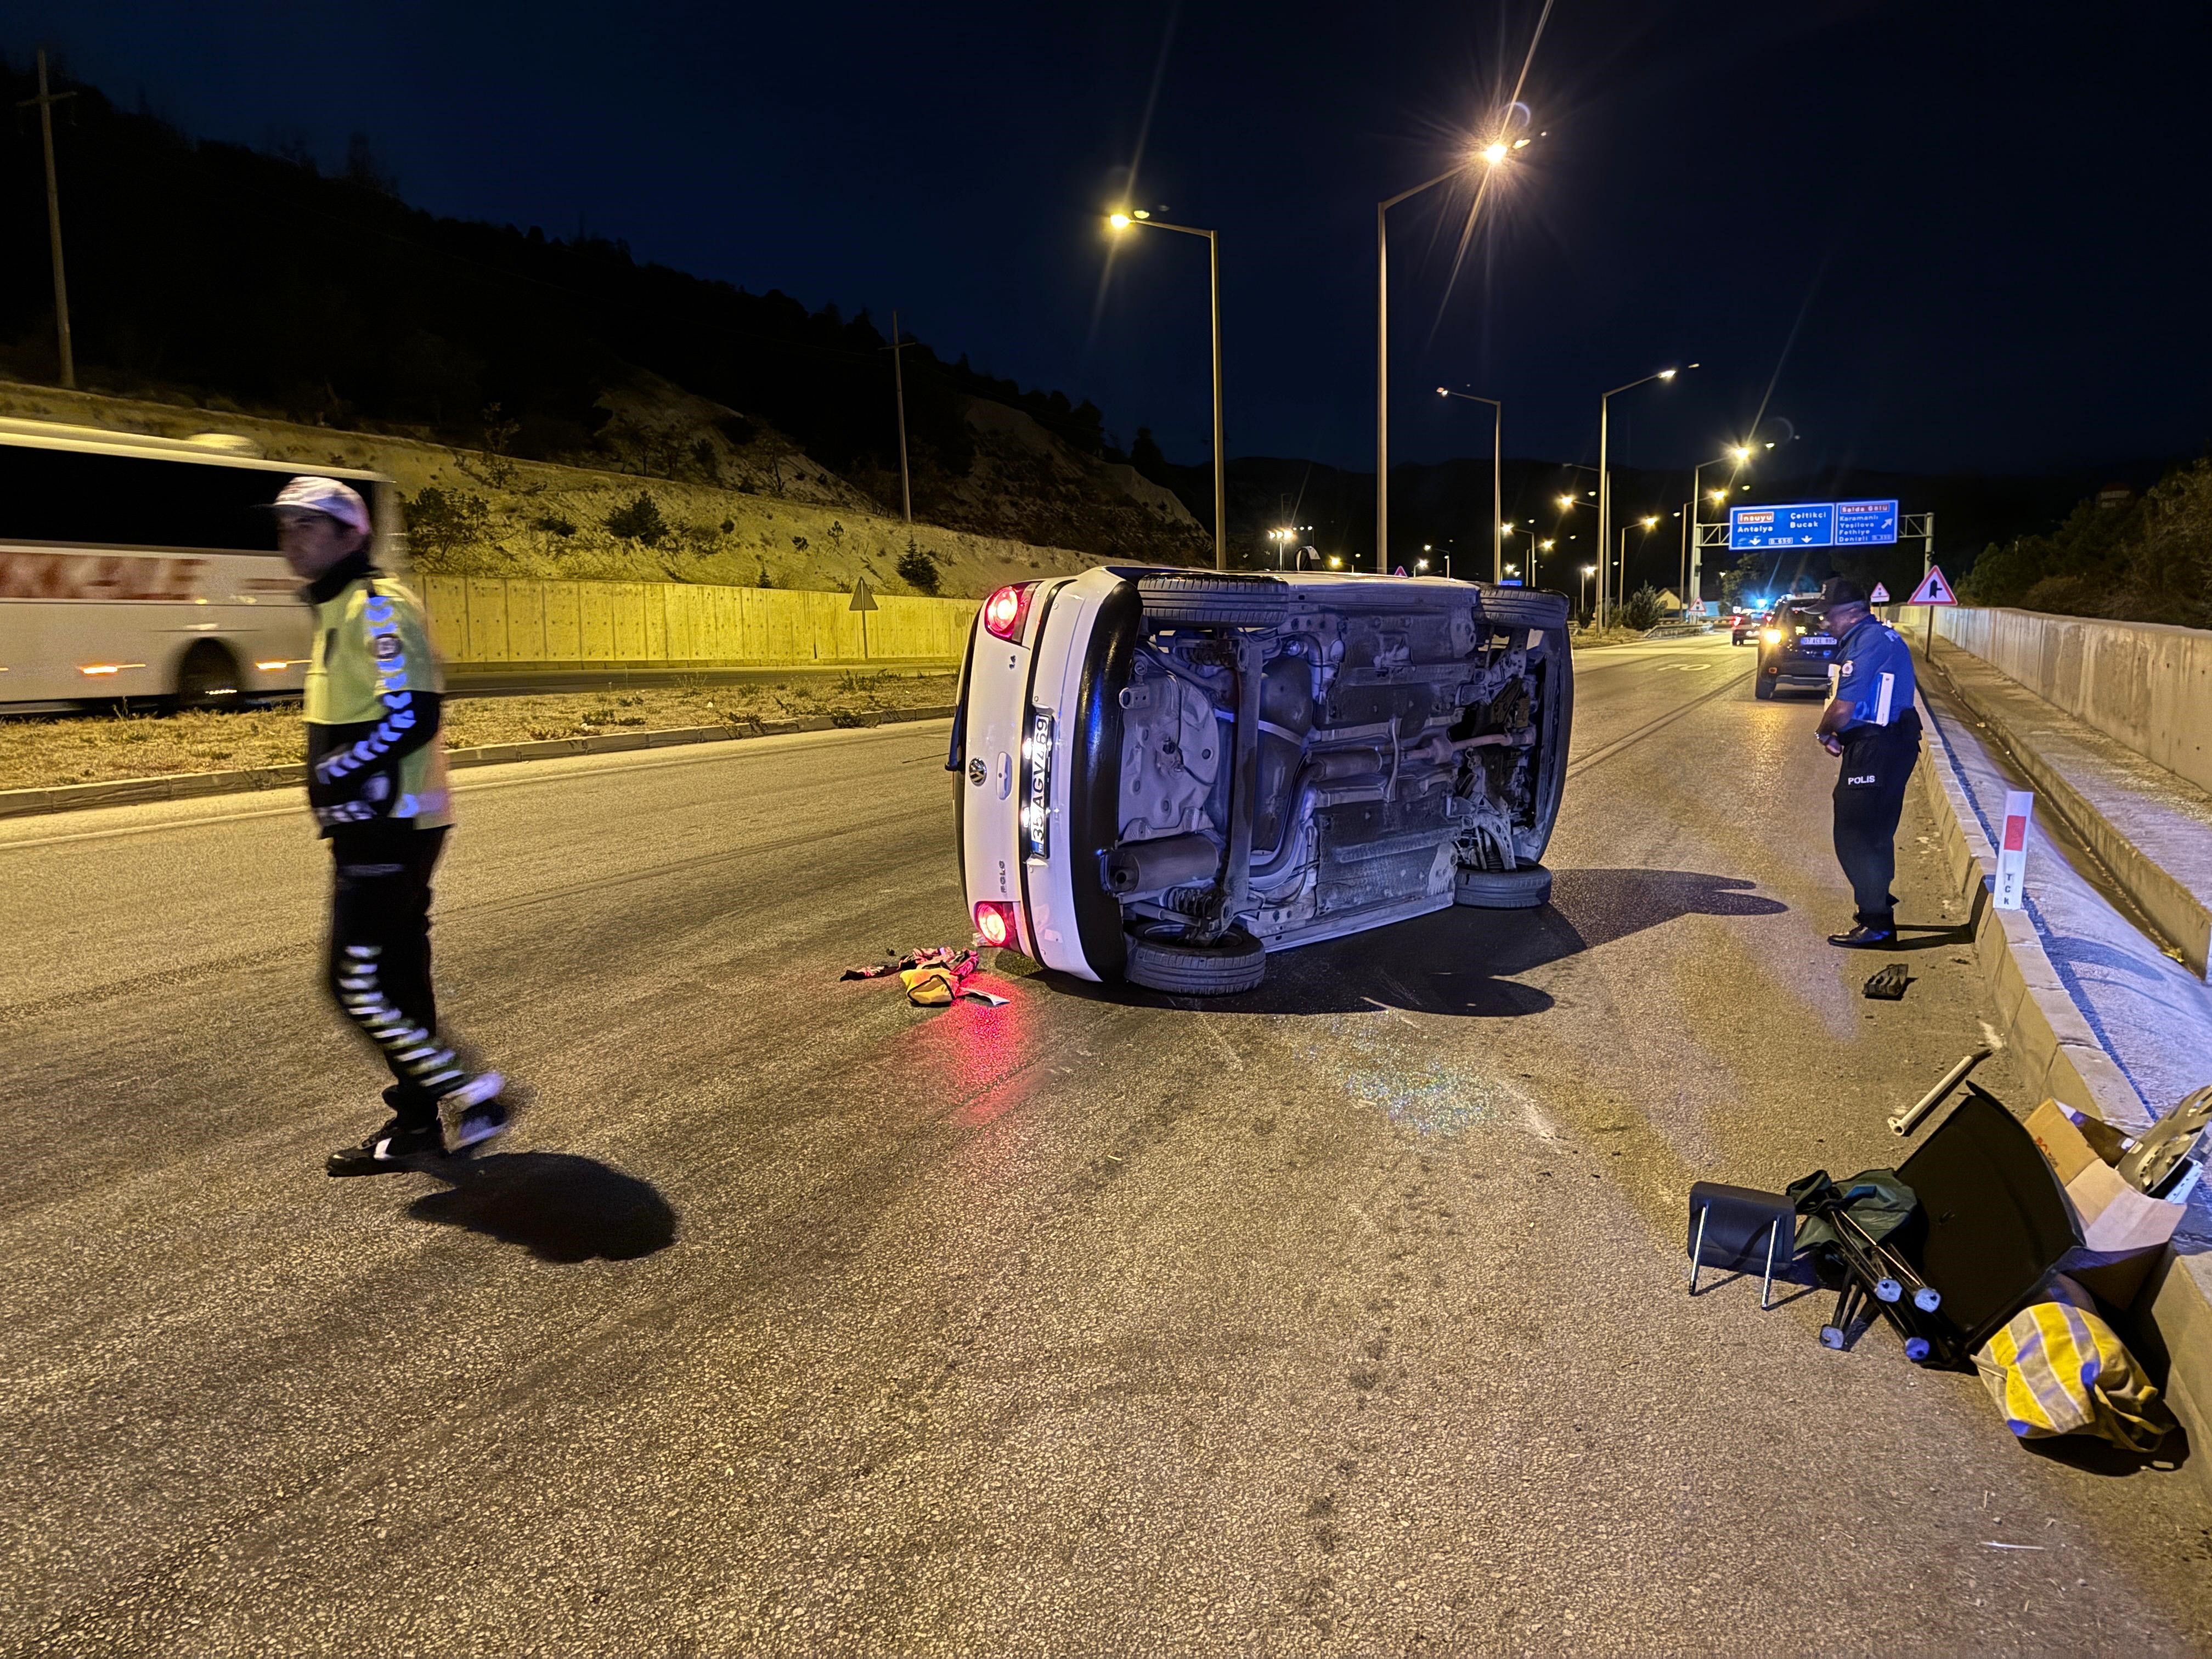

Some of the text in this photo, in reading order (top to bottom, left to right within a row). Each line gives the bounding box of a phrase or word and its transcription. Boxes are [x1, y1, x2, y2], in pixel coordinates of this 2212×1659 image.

[1740, 514, 1773, 522] İnsuyu
[1790, 511, 1826, 520] Çeltikçi
[1033, 761, 1044, 810] AGV
[1033, 815, 1044, 842] 35
[998, 860, 1007, 893] POLO
